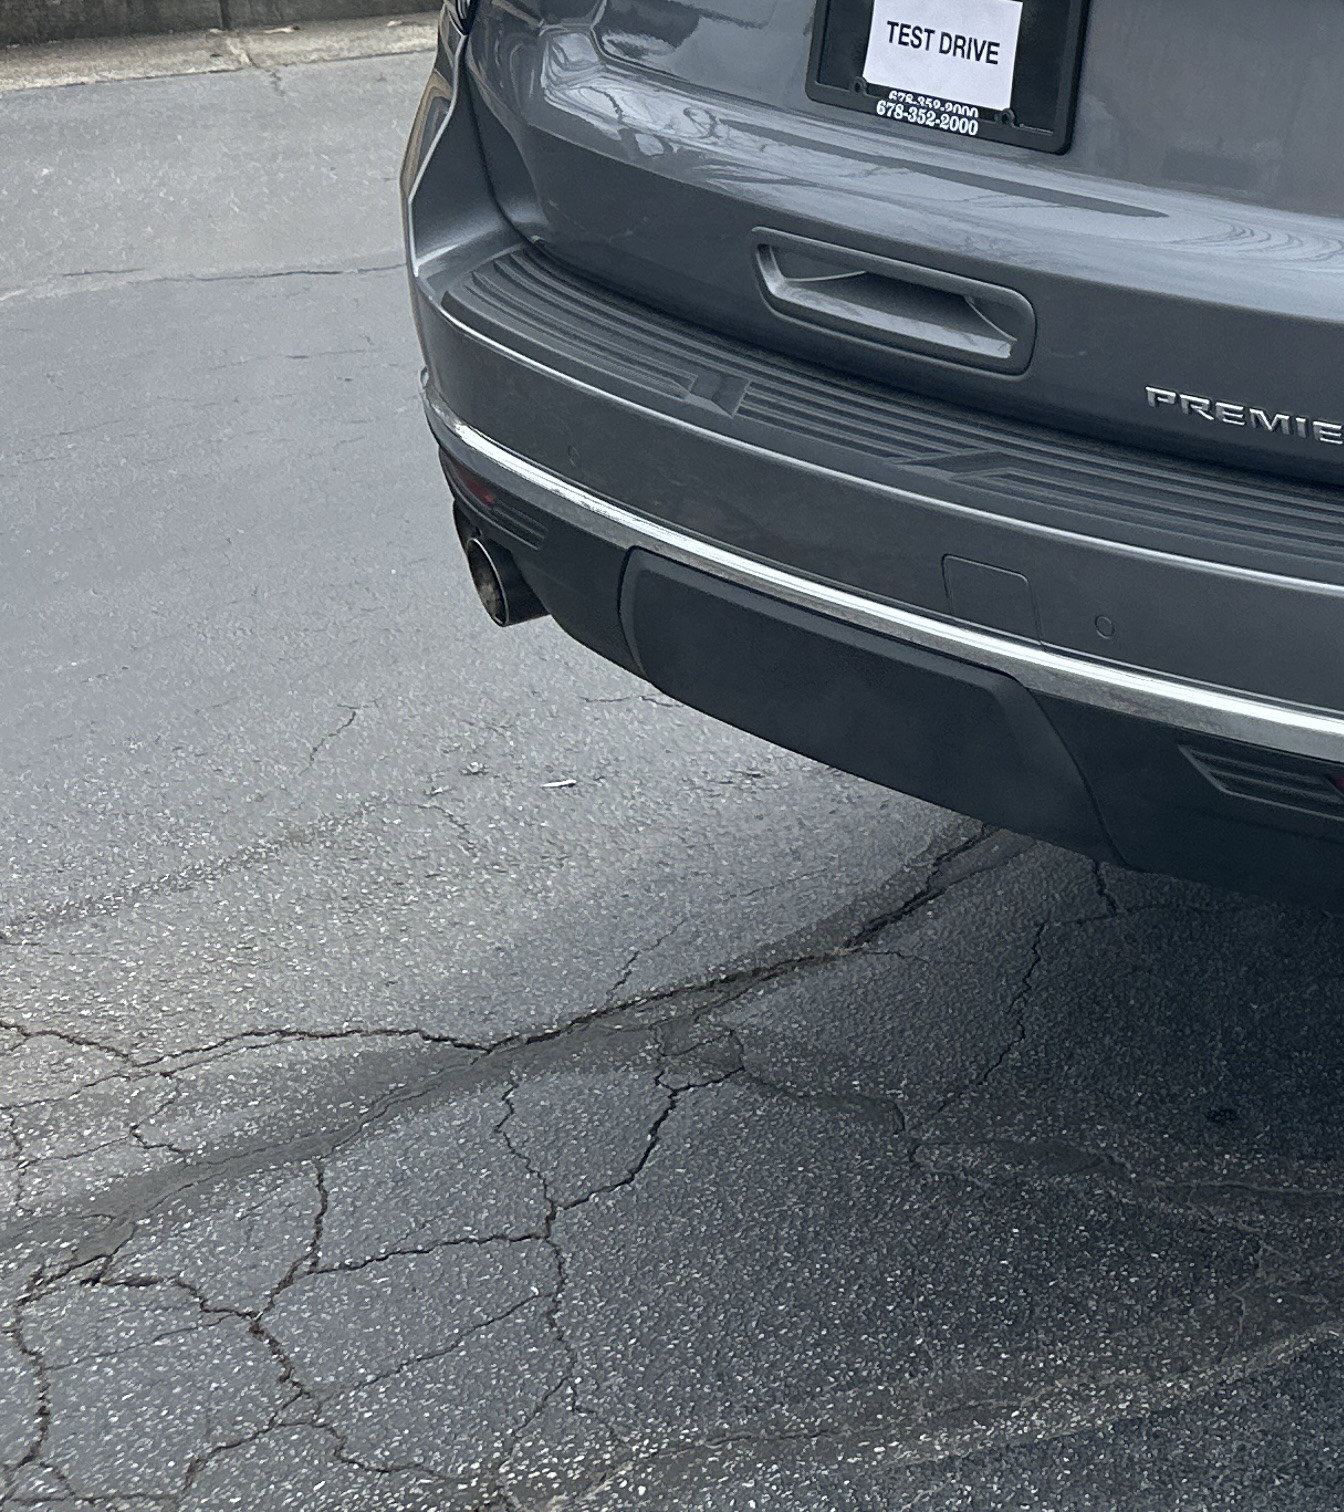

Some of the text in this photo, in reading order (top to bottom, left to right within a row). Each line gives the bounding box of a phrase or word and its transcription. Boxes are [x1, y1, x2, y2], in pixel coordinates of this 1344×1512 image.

[886, 20, 1001, 65] TEST DRIVE
[876, 99, 979, 136] 678-352-2000
